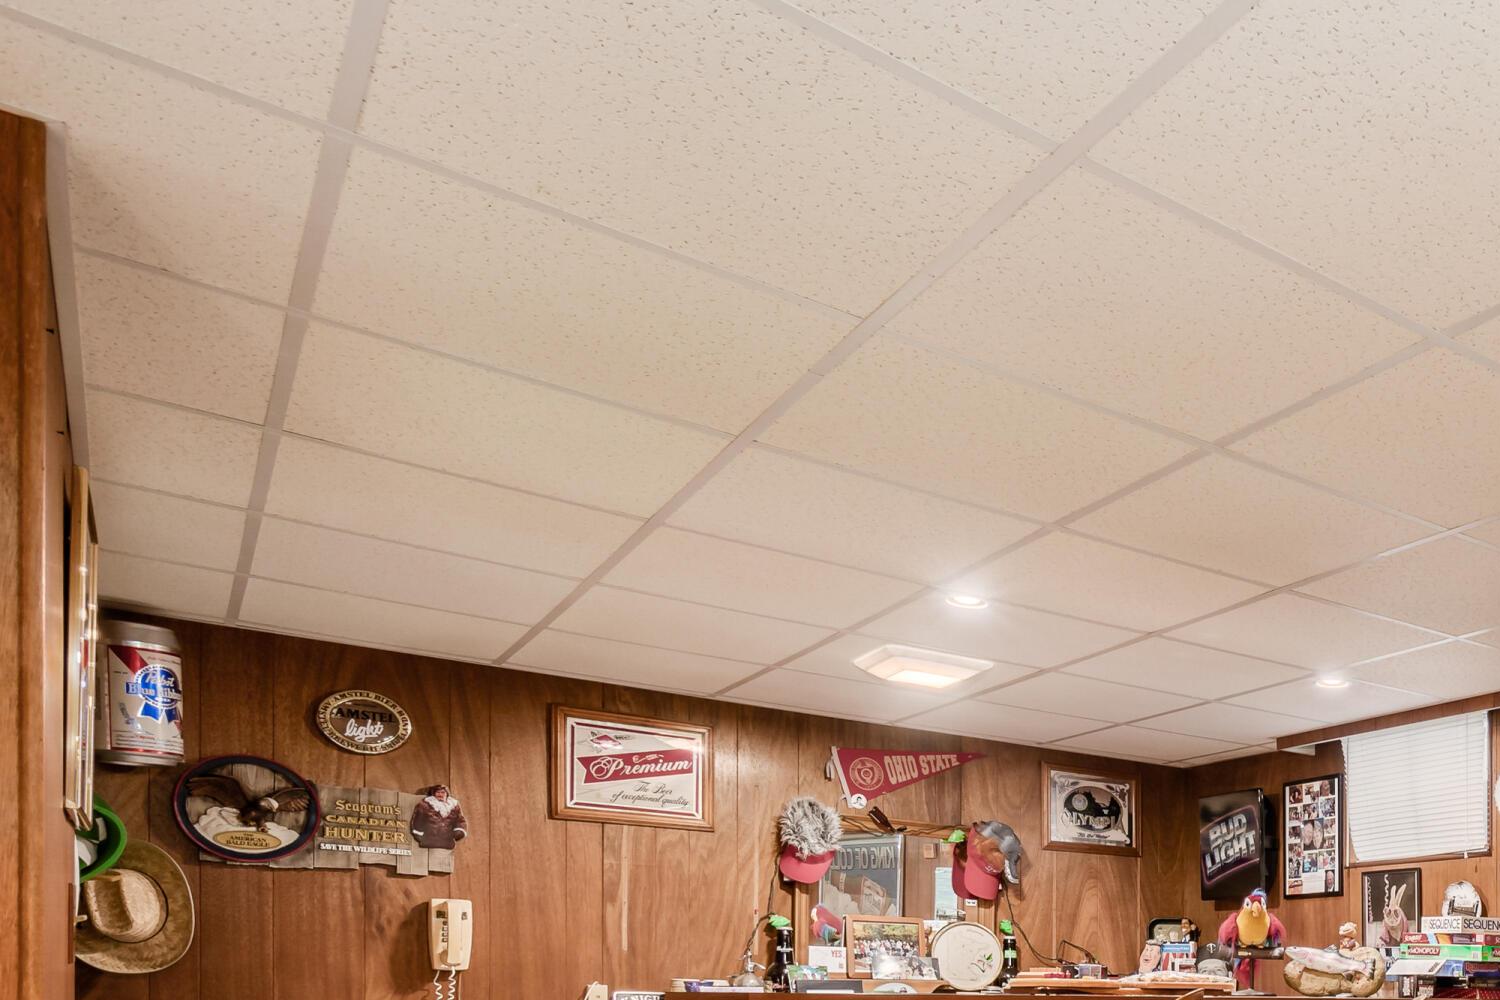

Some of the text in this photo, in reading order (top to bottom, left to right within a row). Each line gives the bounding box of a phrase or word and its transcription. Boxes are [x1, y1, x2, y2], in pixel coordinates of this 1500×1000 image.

[335, 707, 394, 723] AMSTEL
[344, 718, 384, 743] light
[590, 756, 692, 780] Premium
[884, 754, 961, 785] OHIO STATE
[634, 780, 651, 793] The
[335, 799, 401, 815] Seagram's
[325, 814, 407, 829] CANADIAN
[324, 826, 407, 843] HUNTER
[1208, 813, 1248, 851] BUD
[337, 844, 353, 852] THE
[353, 845, 388, 855] WILDLIFE
[1205, 830, 1256, 875] LIGHT
[1429, 917, 1461, 930] SEQUENCE
[1409, 945, 1440, 956] MONOPOLY
